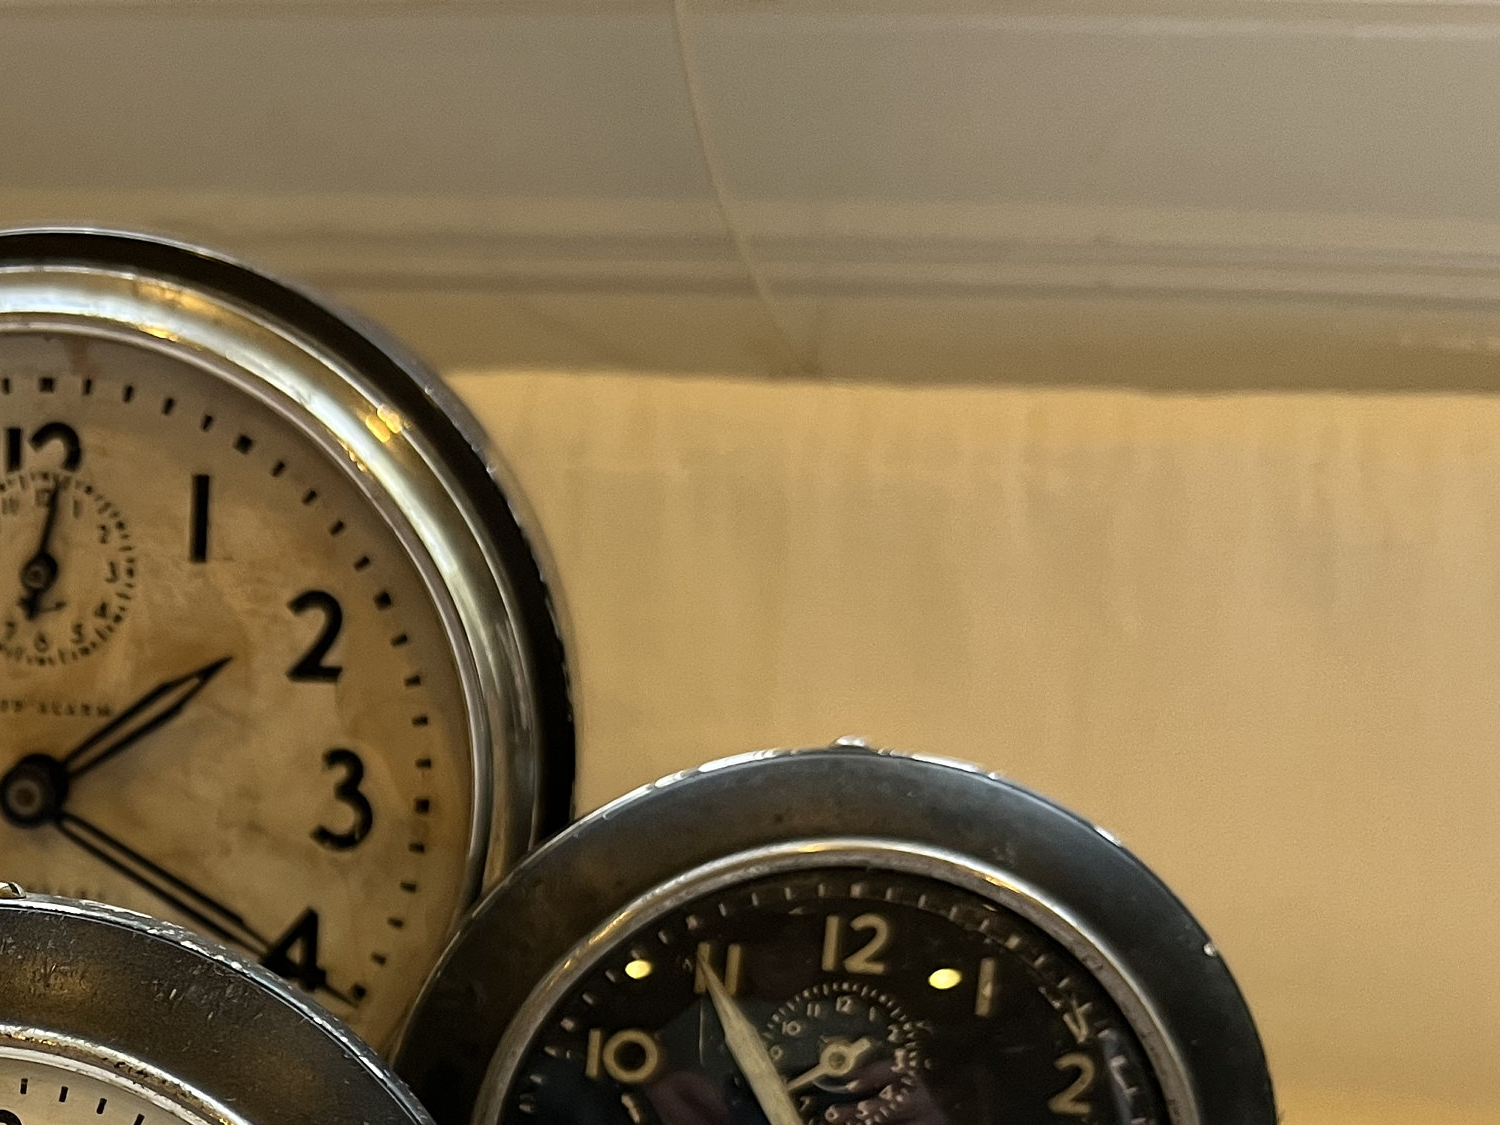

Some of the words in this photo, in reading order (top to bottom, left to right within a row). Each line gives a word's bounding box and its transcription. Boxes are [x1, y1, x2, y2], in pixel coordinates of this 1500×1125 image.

[190, 473, 211, 564] 1
[285, 589, 344, 683] 2
[309, 746, 374, 850] 3
[262, 907, 327, 992] 4
[695, 942, 742, 995] 11
[822, 913, 891, 974] 12
[975, 957, 995, 1017] 1
[585, 1027, 661, 1084] 10
[1050, 1053, 1095, 1115] 2
